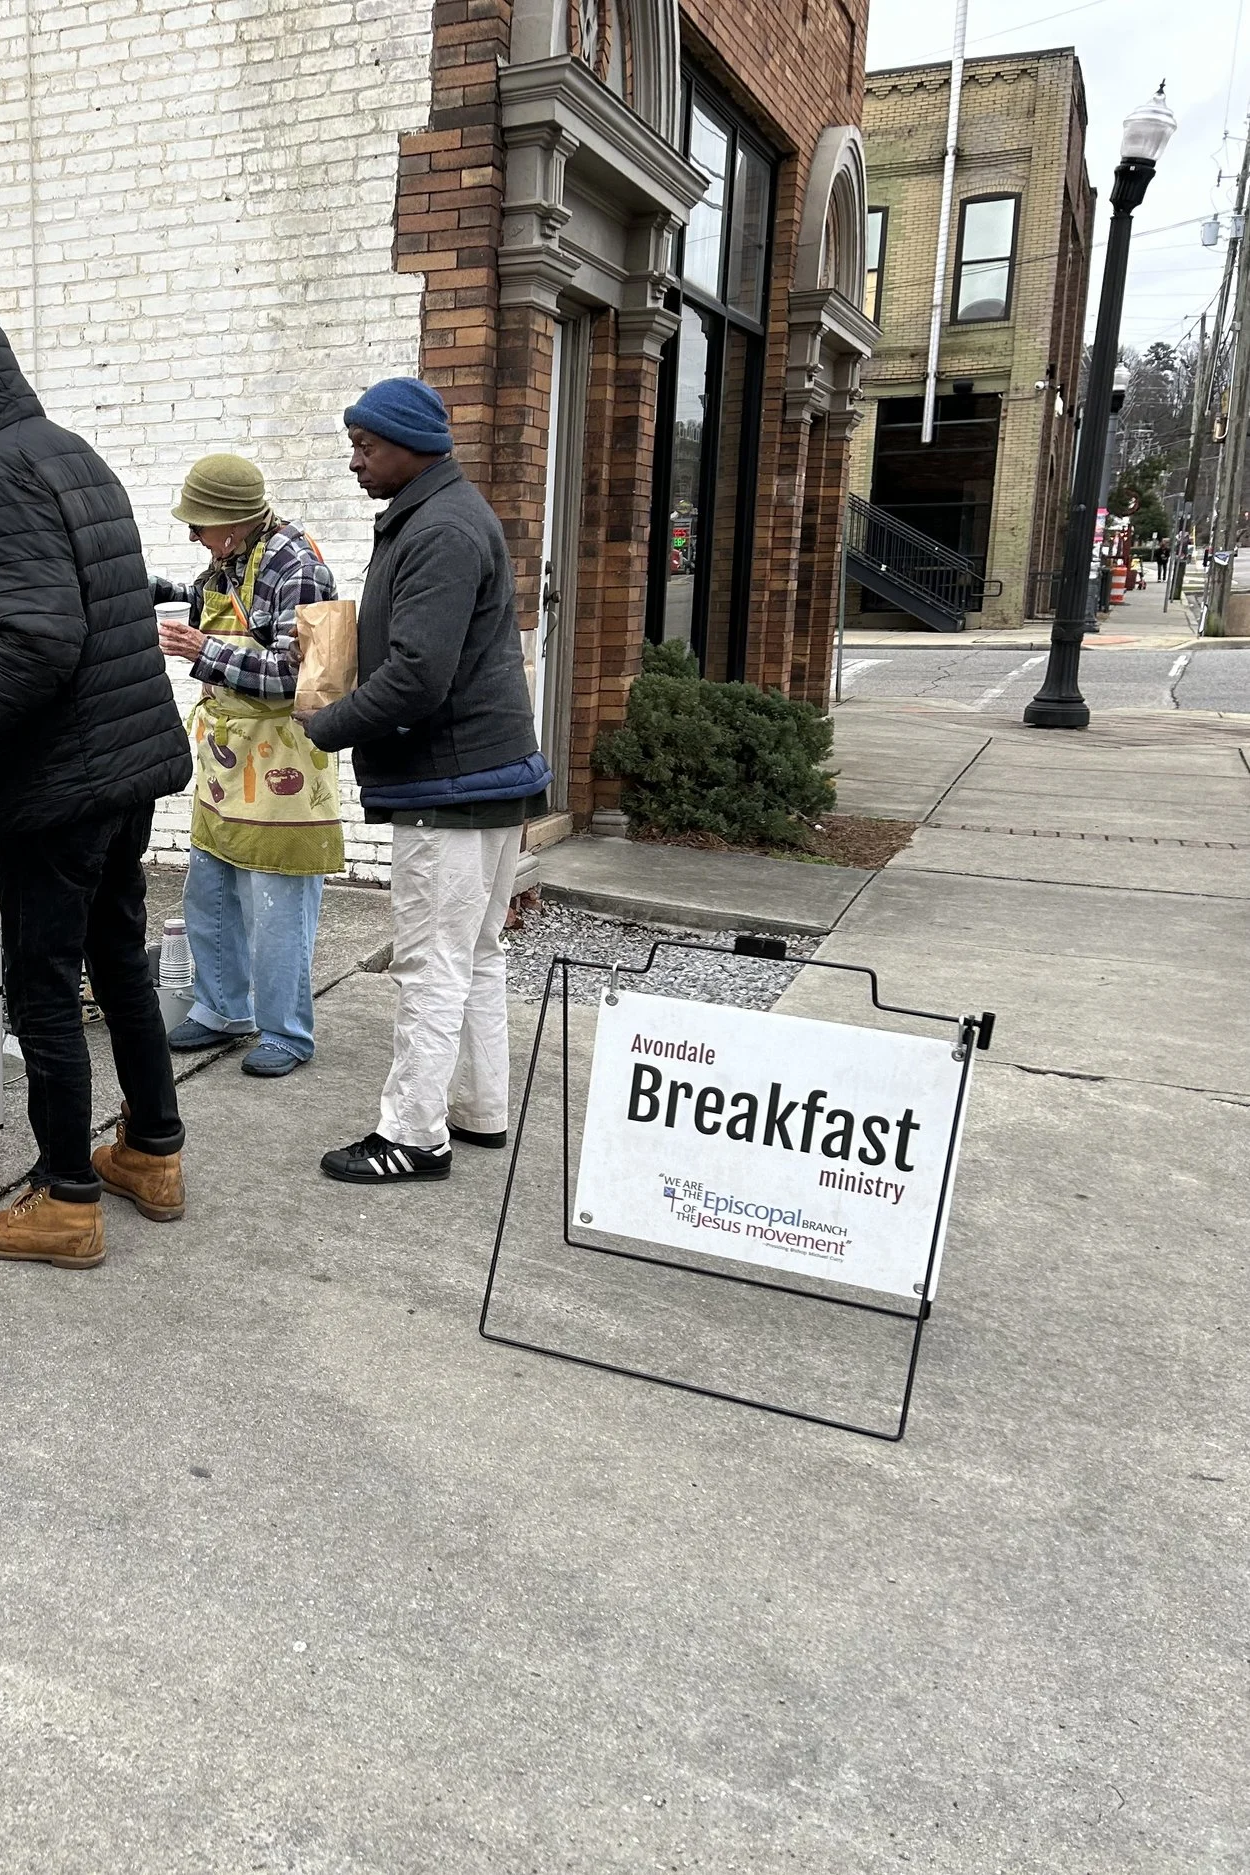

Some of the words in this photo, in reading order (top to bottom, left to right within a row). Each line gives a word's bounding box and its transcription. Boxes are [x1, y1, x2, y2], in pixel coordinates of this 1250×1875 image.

[631, 1033, 716, 1066] Avondale
[627, 1062, 921, 1172] Breakfast
[682, 1179, 705, 1192] ARE
[818, 1168, 906, 1205] ministry
[676, 1211, 696, 1224] THE
[692, 1212, 742, 1234] Jesus
[682, 1203, 698, 1214] OF
[682, 1188, 703, 1201] THE
[703, 1190, 802, 1228] Episcopal
[802, 1219, 848, 1237] BRANCH
